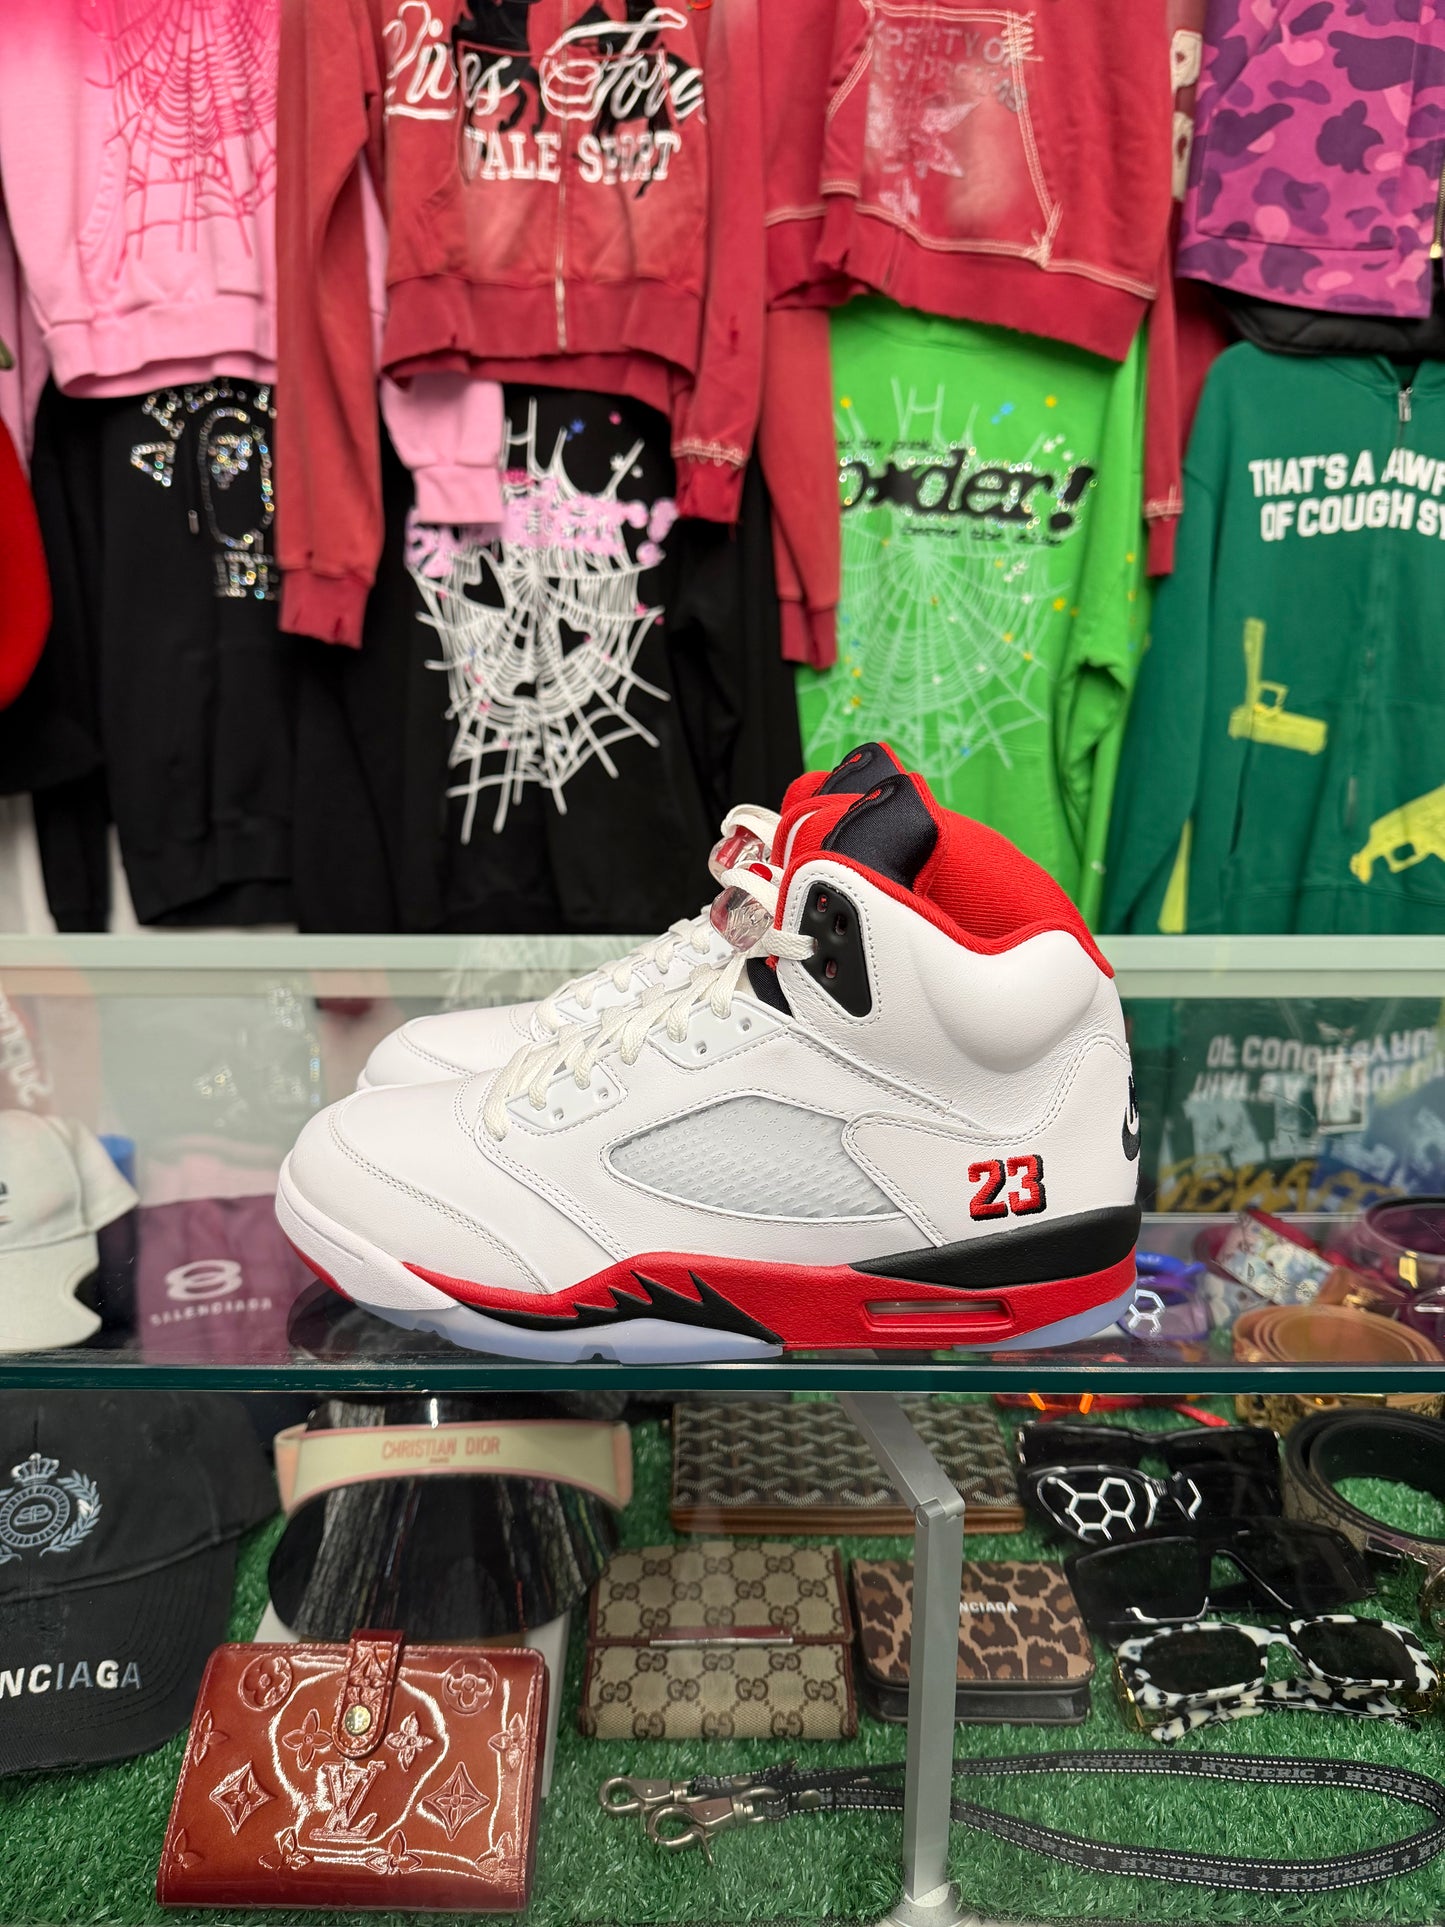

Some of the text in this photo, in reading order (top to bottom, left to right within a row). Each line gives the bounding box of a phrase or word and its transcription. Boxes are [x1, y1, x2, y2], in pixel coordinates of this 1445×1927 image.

[1248, 453, 1350, 498] THAT'S
[1350, 449, 1376, 487] A
[1260, 501, 1296, 542] OF
[1297, 488, 1417, 538] COUGH
[967, 1153, 1048, 1222] 23
[382, 1434, 501, 1461] CHRISTIAN DIOR
[0, 1660, 143, 1699] NCIAGA
[1058, 1758, 1171, 1769] HYSTERIC
[1201, 1760, 1316, 1779] HYSTERIC
[1119, 1856, 1246, 1883] HYSTERIC
[1280, 1856, 1394, 1887] HYSTERIC
